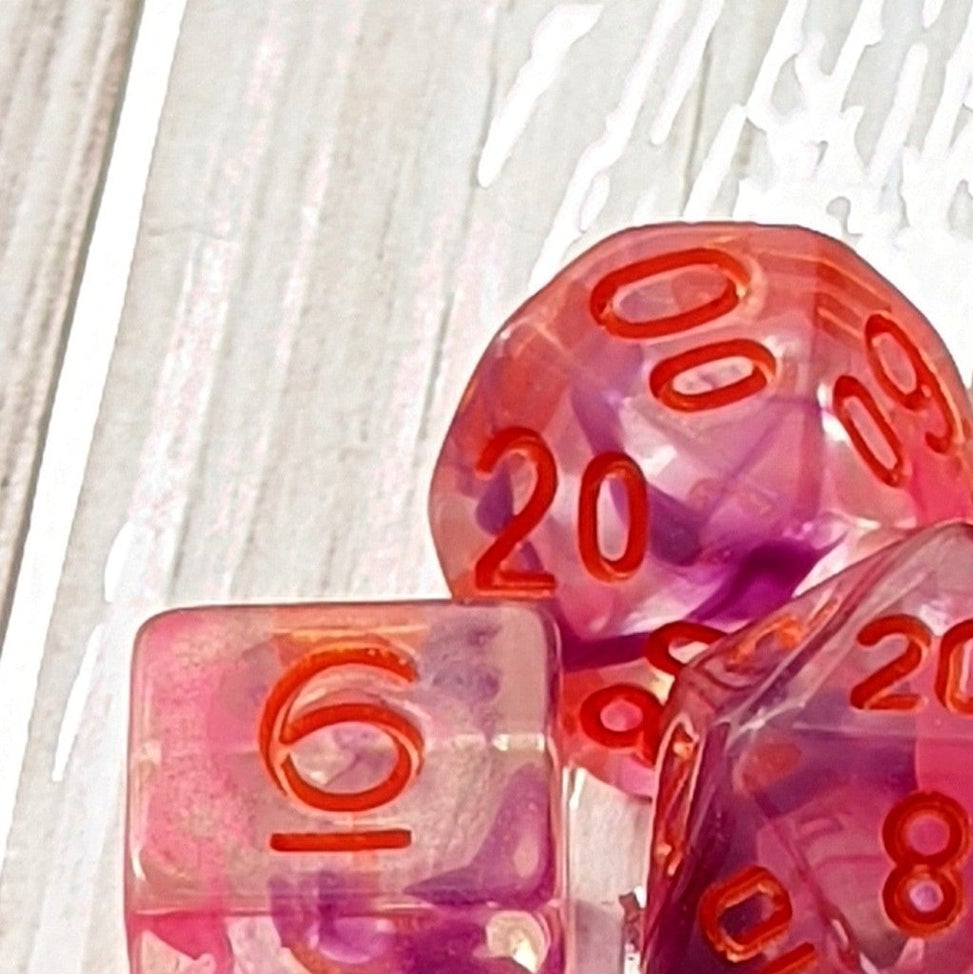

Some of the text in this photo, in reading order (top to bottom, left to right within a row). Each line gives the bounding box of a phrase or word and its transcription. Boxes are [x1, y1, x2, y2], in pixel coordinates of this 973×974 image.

[590, 247, 778, 412] 00
[473, 425, 648, 592] 20
[882, 790, 972, 938] 8
